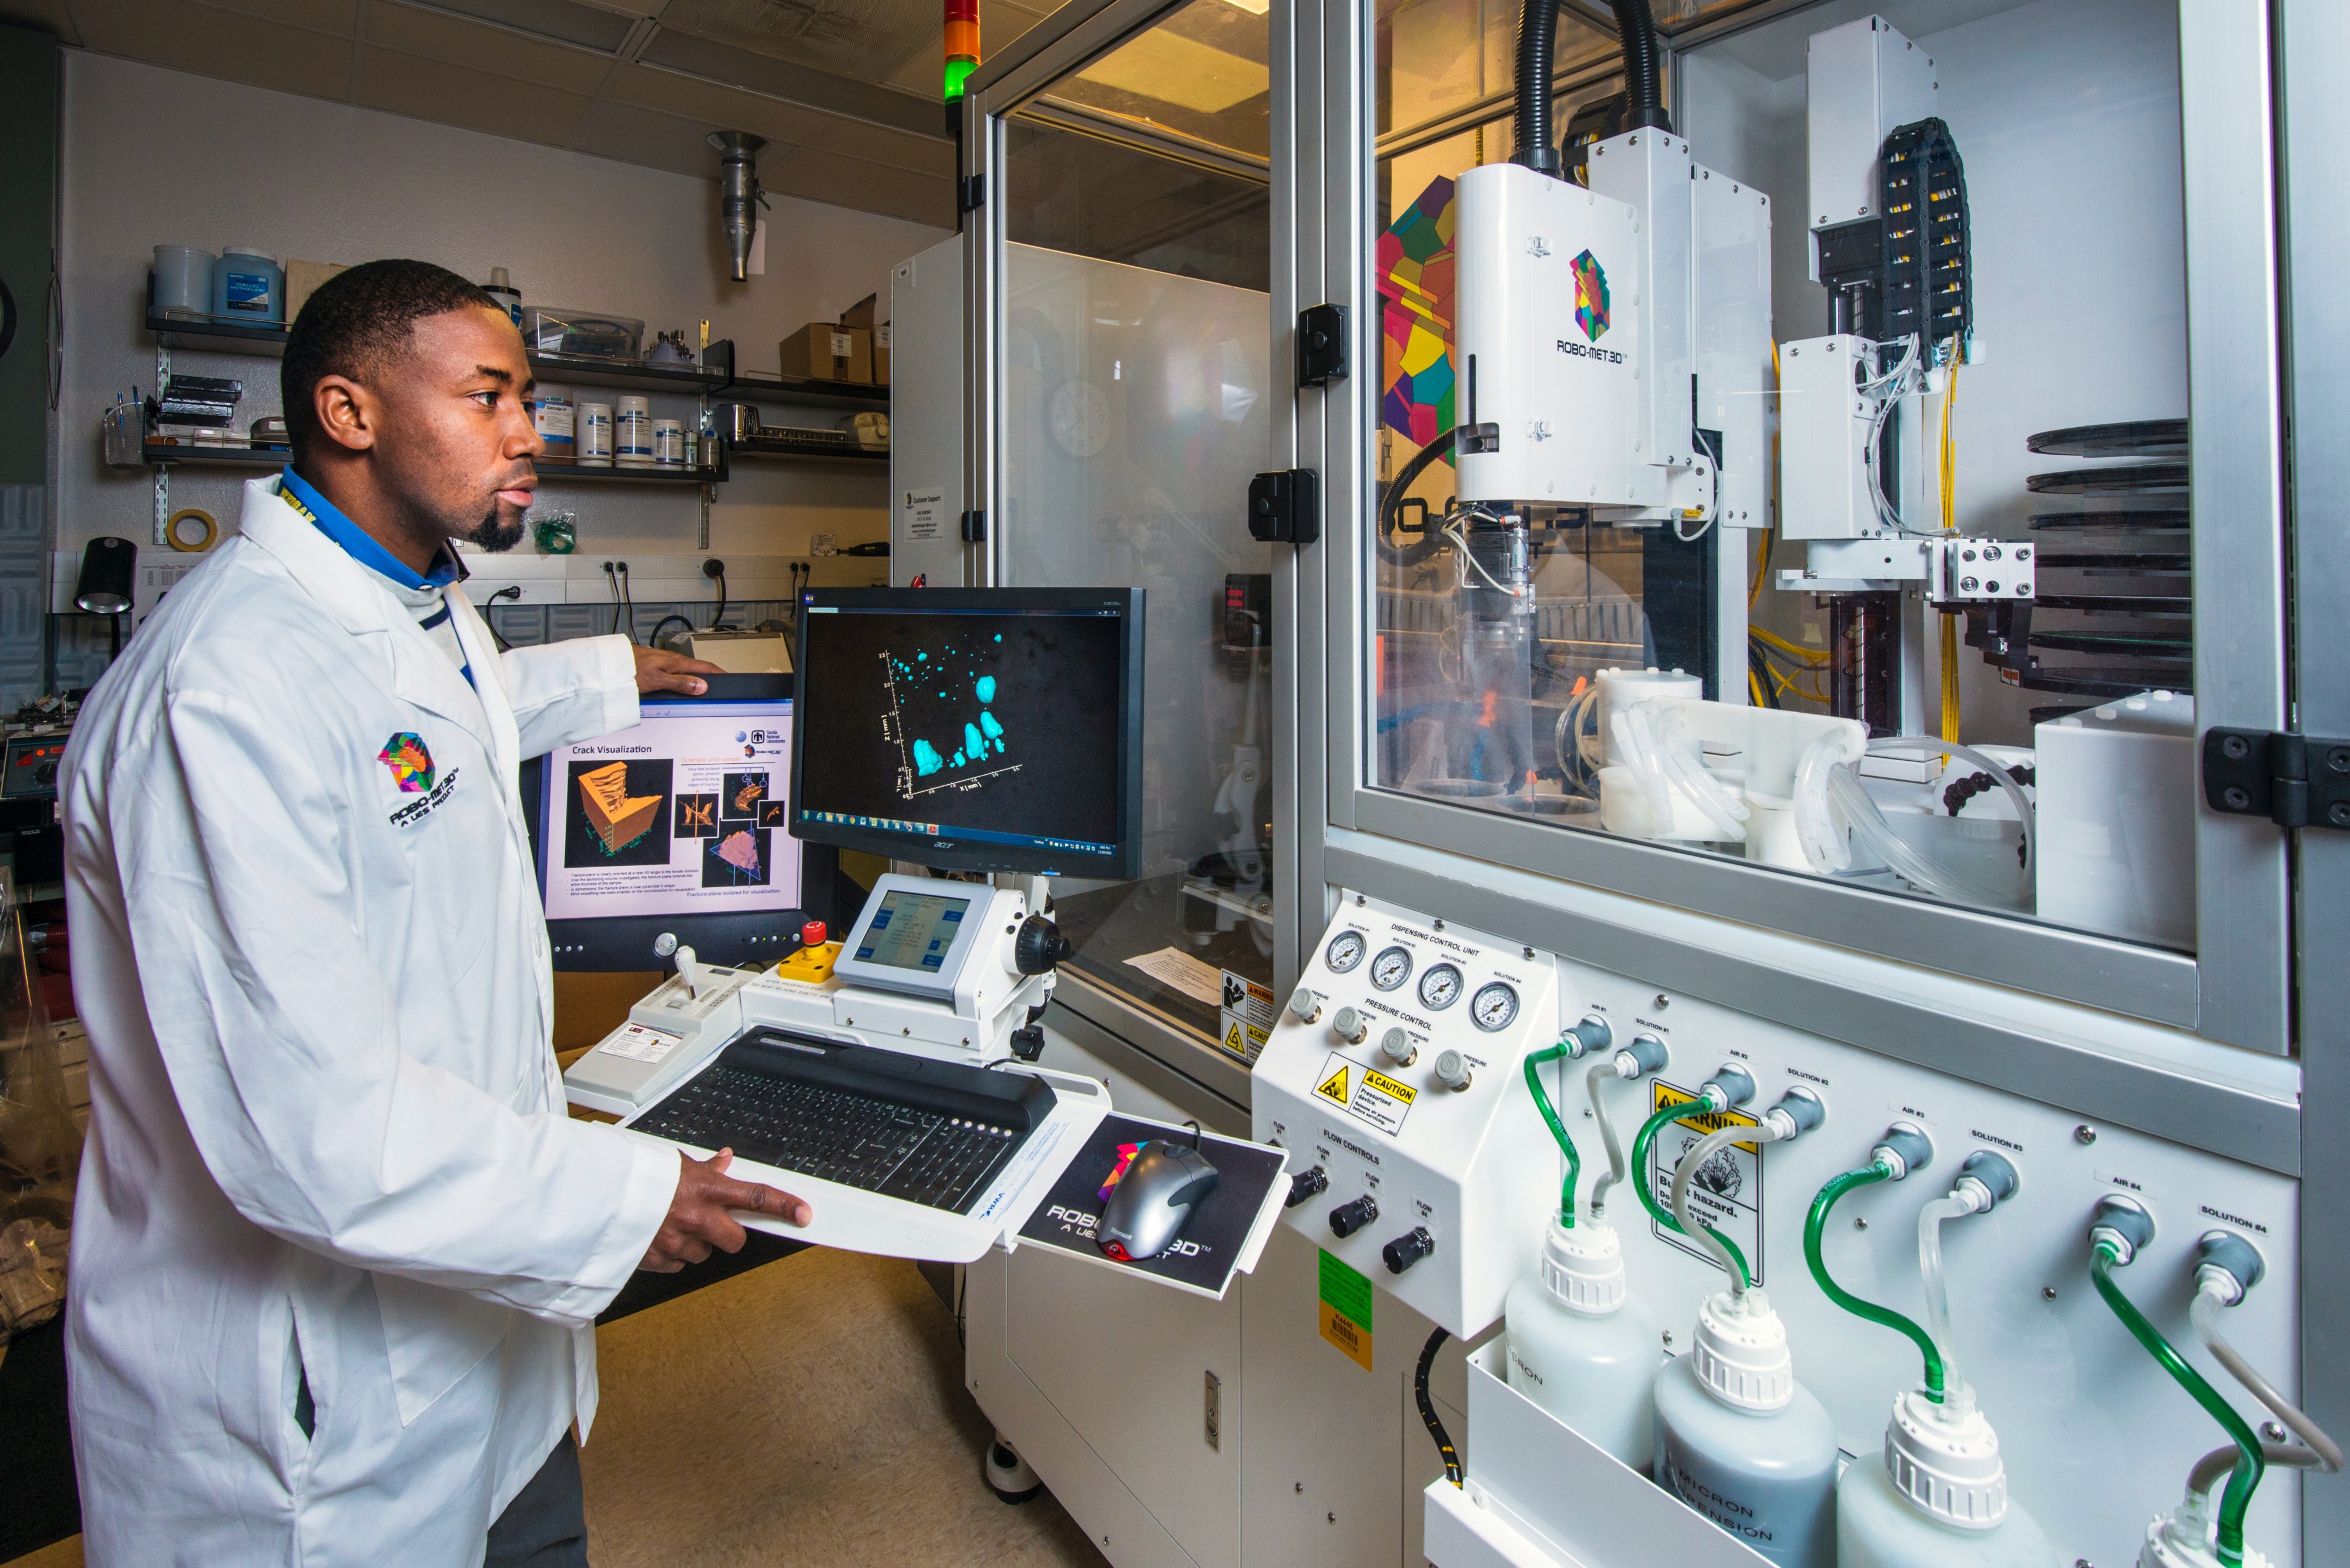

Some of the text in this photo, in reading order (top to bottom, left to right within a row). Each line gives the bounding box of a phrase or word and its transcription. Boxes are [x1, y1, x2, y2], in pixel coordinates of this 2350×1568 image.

[1557, 340, 1622, 364] ROBO-MET.3D
[572, 745, 652, 754] Crack Visualization
[410, 785, 455, 821] UES PRODUCT
[1348, 922, 1365, 931] SOLUTION
[1391, 924, 1479, 957] DISPENSING CONTROL UNIT
[1392, 937, 1411, 946] SOLUTION
[1441, 953, 1461, 963] SOLUTION
[1493, 971, 1515, 982] SOLUTION
[1365, 998, 1432, 1030] PRESSURE CONTROL
[1636, 1018, 1663, 1031] SOLUTION
[1788, 1067, 1819, 1083] SOLUTION
[1375, 1077, 1414, 1100] CAUTION
[1358, 1094, 1376, 1107] device.
[1361, 1088, 1392, 1107] Pressurized
[1352, 1105, 1385, 1125] before servicing.
[1355, 1101, 1371, 1112] Release
[1377, 1113, 1396, 1124] pressure
[1902, 1106, 1915, 1115] AIR
[1273, 1120, 1285, 1131] FLOW
[1972, 1130, 2012, 1148] SOLUTION
[1317, 1144, 1330, 1157] FLOW
[1324, 1129, 1379, 1165] FLOW CONTROLS
[1365, 1171, 1380, 1184] FLOW
[2113, 1177, 2141, 1191] AIR #4
[1369, 1181, 1376, 1189] #3
[988, 1193, 1005, 1210] VWR
[1416, 1200, 1432, 1213] FLOW
[1660, 1190, 1717, 1222] Do exceed
[1694, 1190, 1737, 1218] hazard.
[1697, 1216, 1712, 1228] kPa
[2201, 1206, 2267, 1234] SOLUTION #4
[1060, 1224, 1072, 1232] A
[1110, 1227, 1133, 1241] Microsoft
[1679, 1469, 1753, 1517] MICRON
